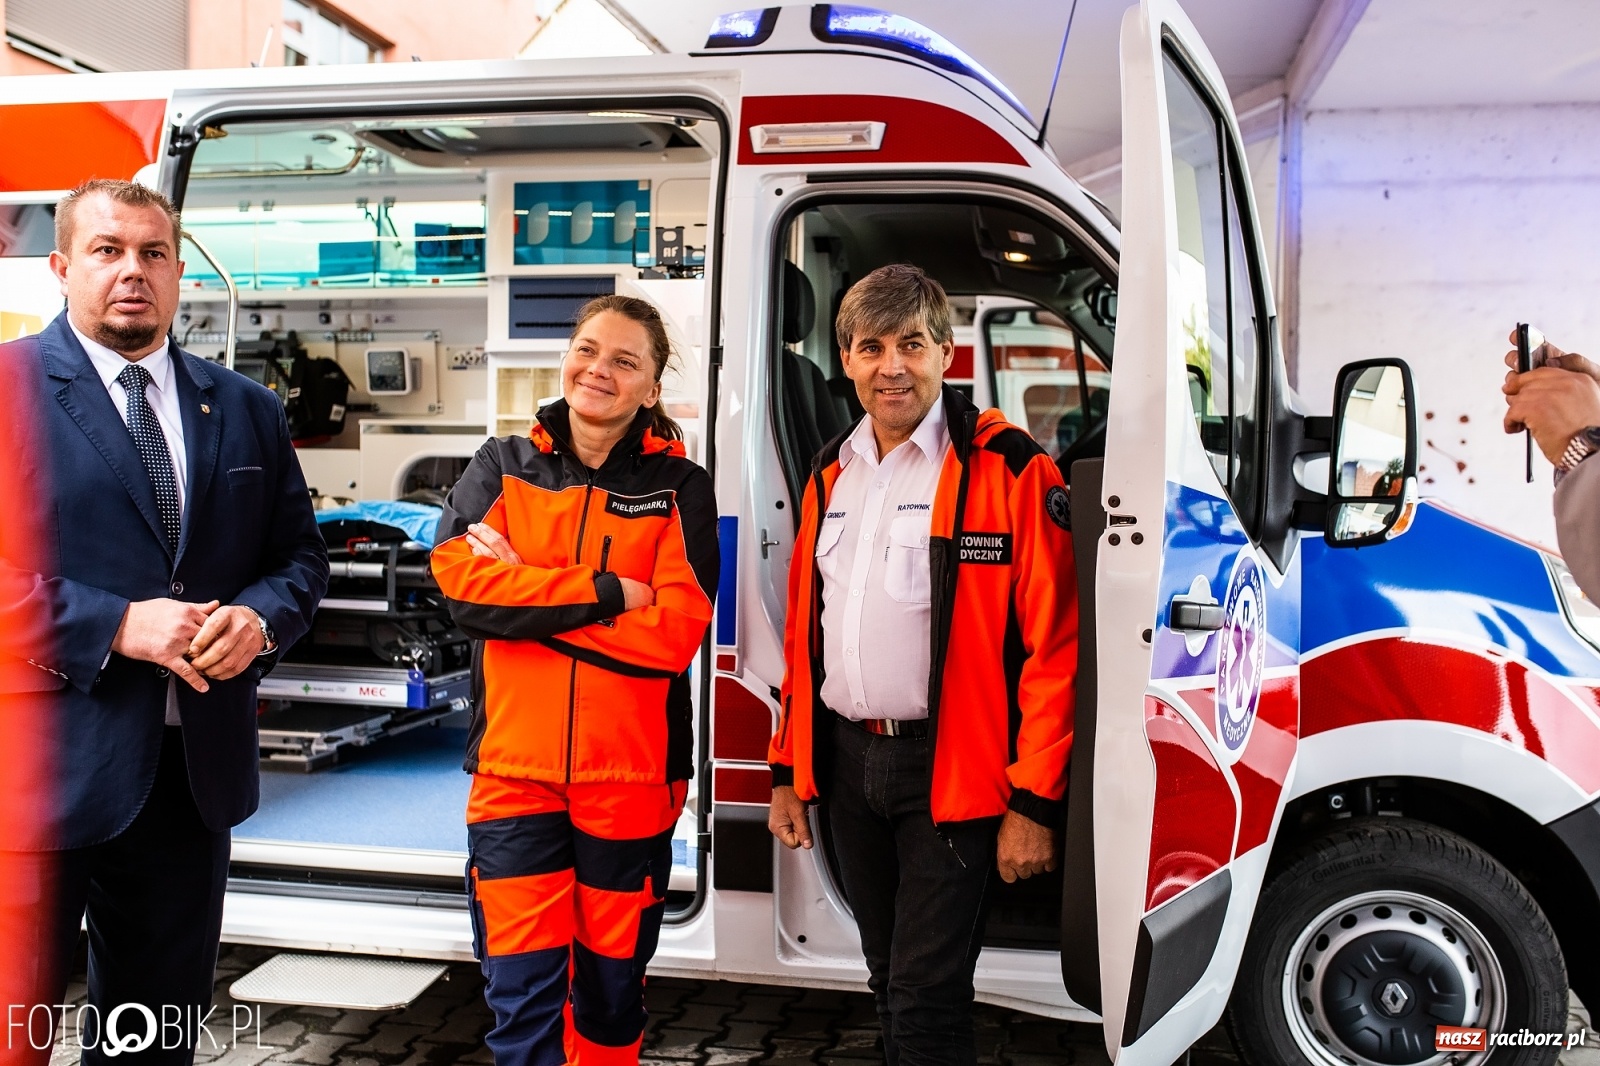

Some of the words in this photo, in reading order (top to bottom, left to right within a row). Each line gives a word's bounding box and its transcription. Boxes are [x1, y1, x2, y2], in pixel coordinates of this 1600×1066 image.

[611, 500, 668, 514] PIELĘGNIARKA
[897, 503, 931, 512] RATOWNIK
[960, 536, 1004, 548] TOWNIK
[960, 549, 1003, 561] DYCZNY
[359, 687, 387, 697] MEC
